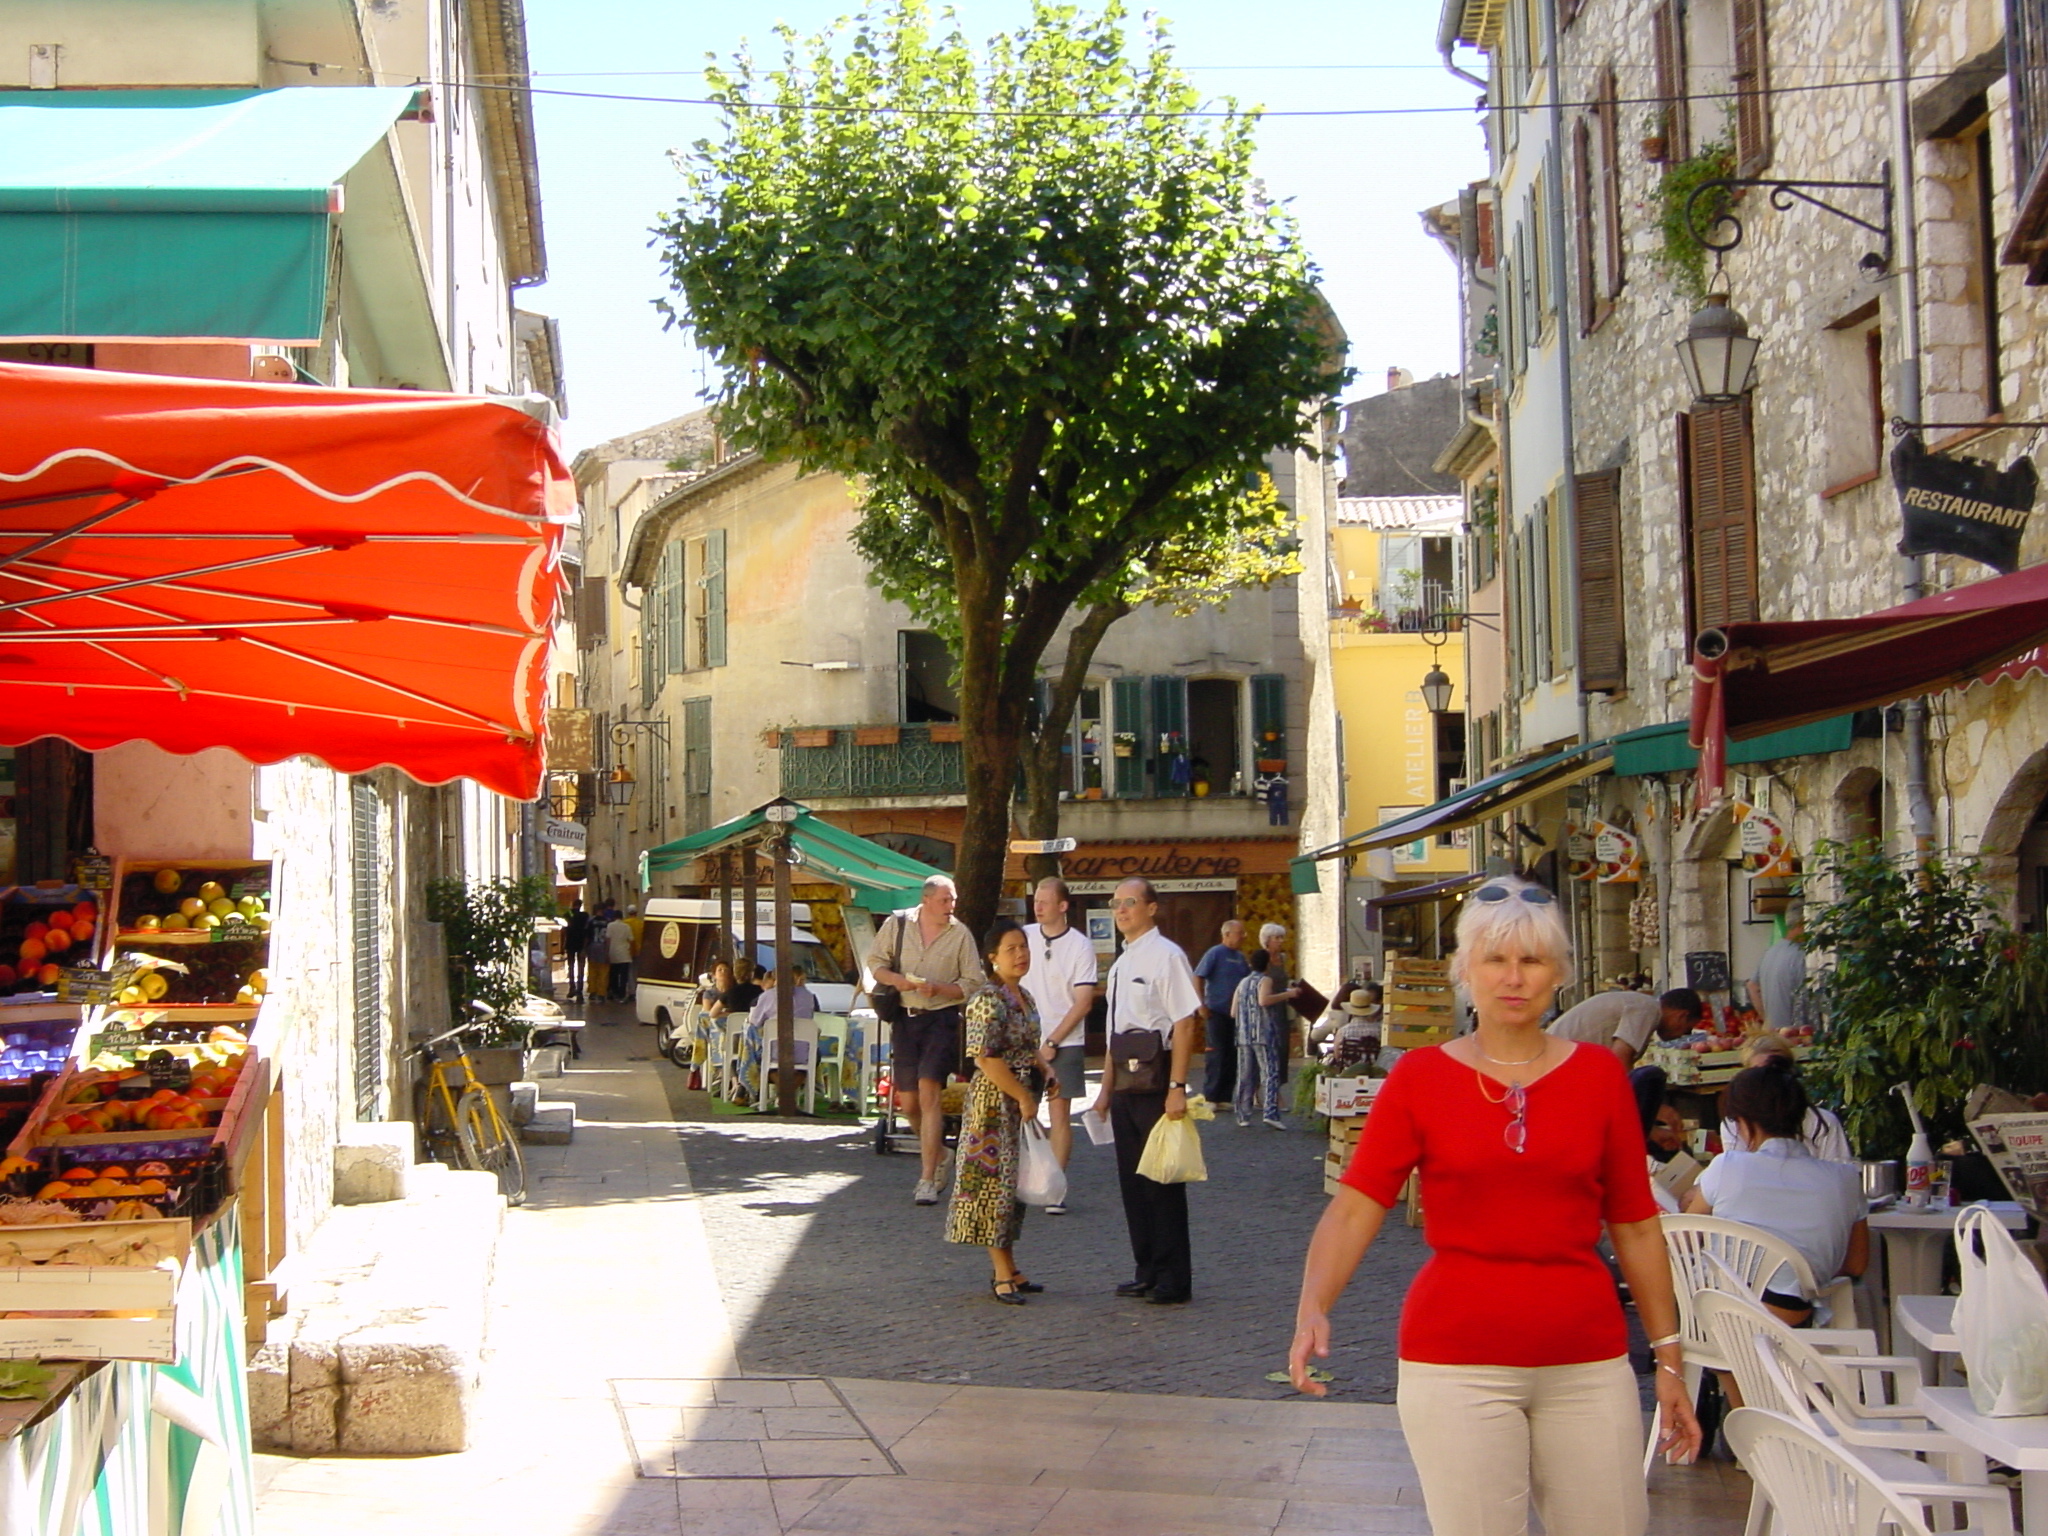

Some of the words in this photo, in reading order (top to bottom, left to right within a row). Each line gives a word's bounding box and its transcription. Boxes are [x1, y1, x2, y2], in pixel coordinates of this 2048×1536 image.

[1904, 486, 2029, 529] RESTAURANT
[1405, 708, 1425, 798] ATELIER
[546, 821, 586, 841] Traiteur
[1179, 880, 1225, 893] repas
